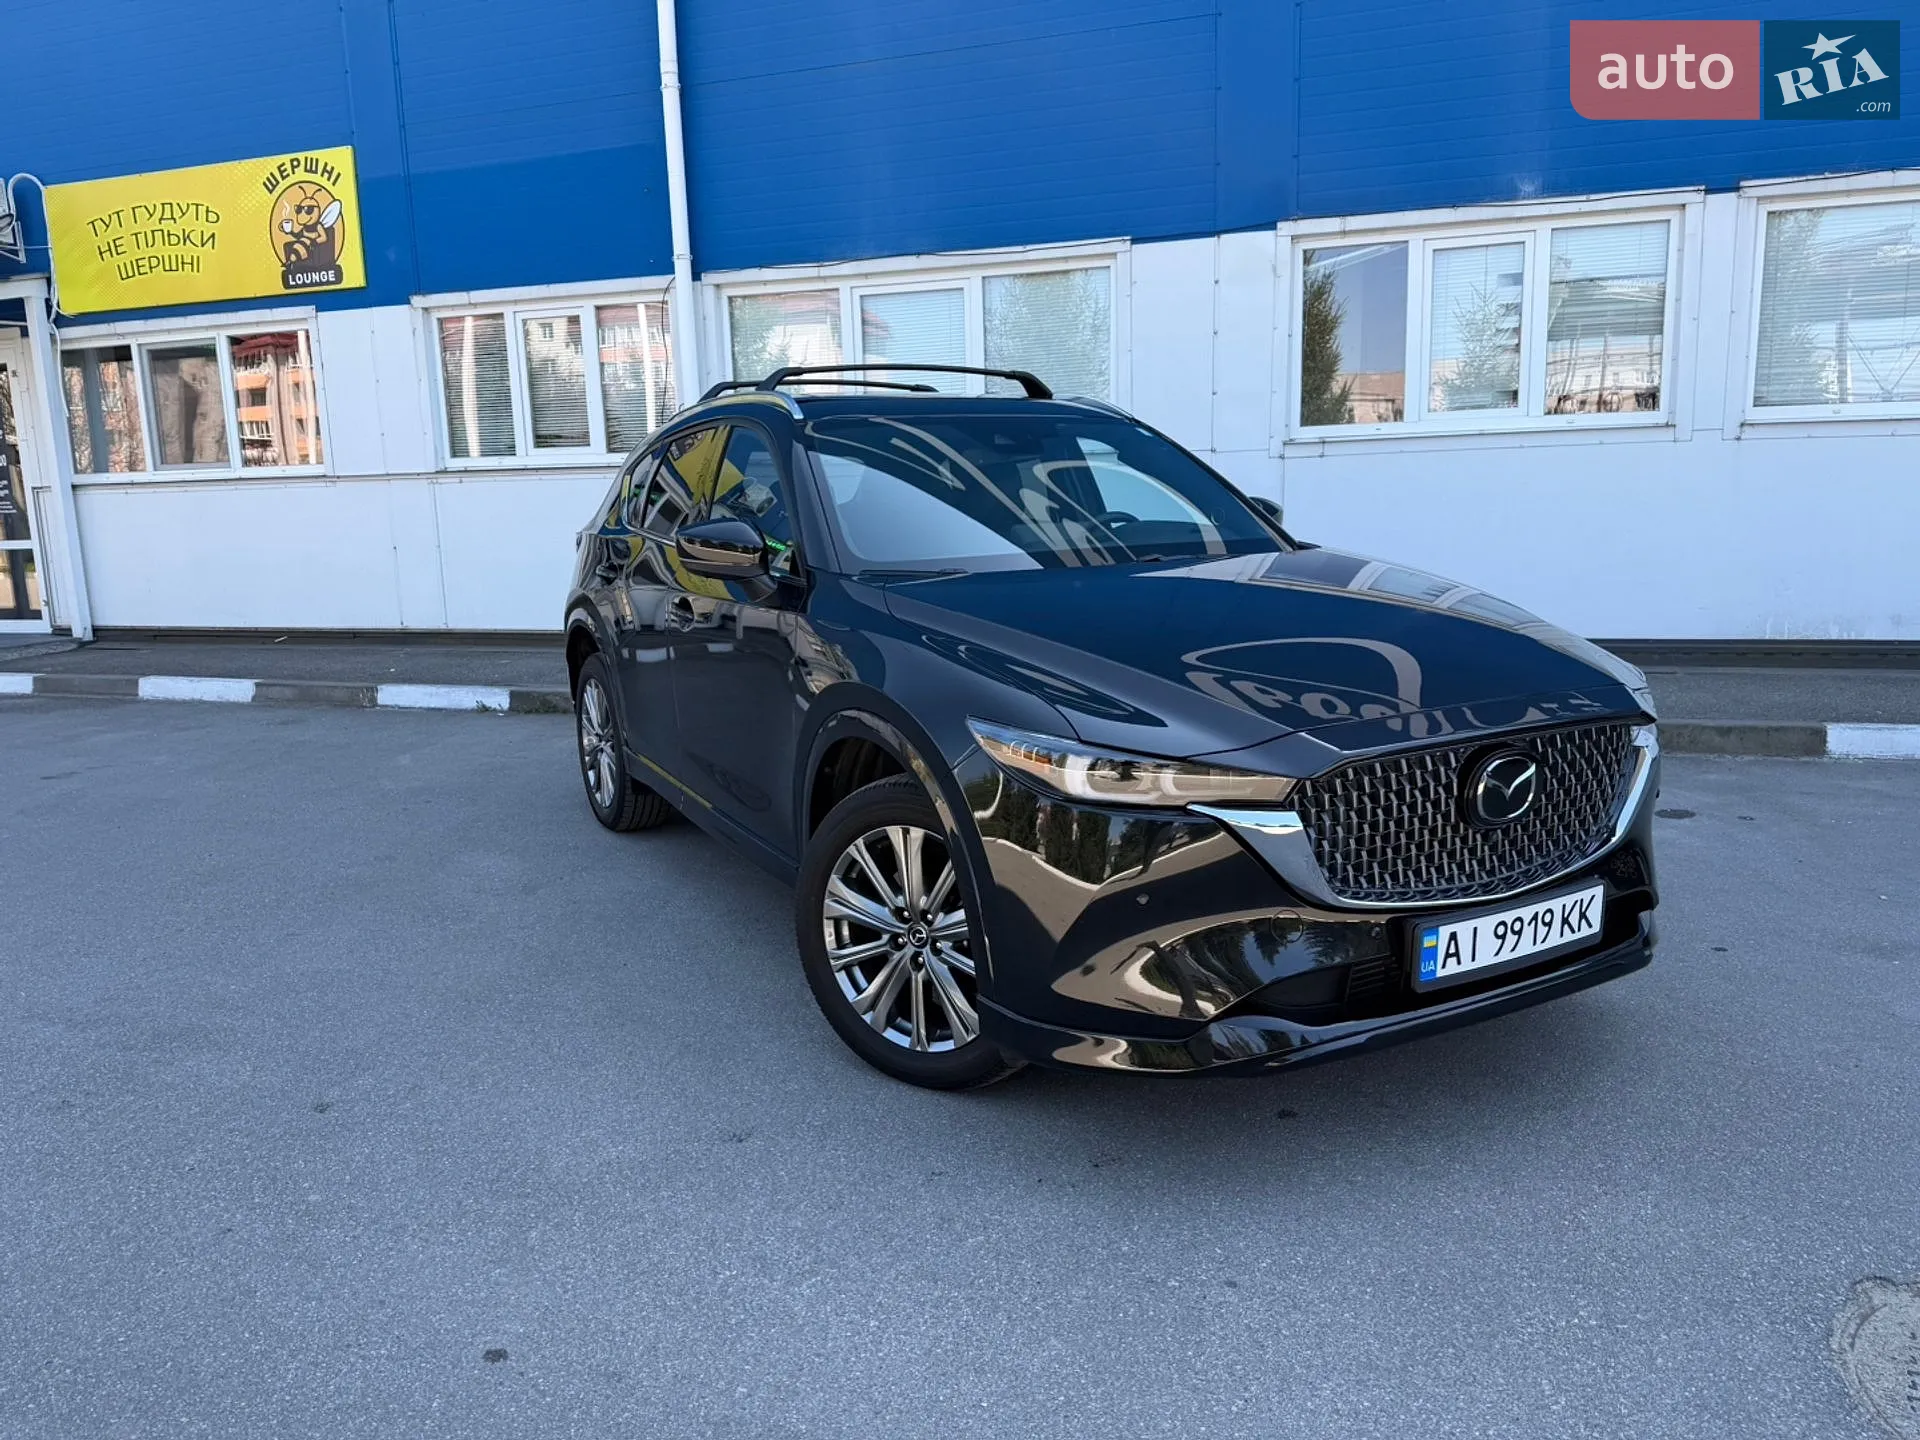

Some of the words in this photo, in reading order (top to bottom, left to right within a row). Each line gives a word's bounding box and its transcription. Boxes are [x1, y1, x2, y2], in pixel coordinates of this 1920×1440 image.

[262, 156, 341, 195] ШЕРШНІ
[87, 209, 127, 238] ТУТ
[131, 202, 221, 226] ГУДУТЬ
[97, 237, 128, 262] НЕ
[131, 227, 217, 251] ТІЛЬКИ
[116, 255, 200, 282] ШЕРШНІ
[288, 270, 336, 286] LOUNGE
[1441, 926, 1478, 969] AI
[1493, 908, 1555, 957] 9919
[1560, 894, 1596, 938] KK
[1421, 960, 1436, 973] UA
